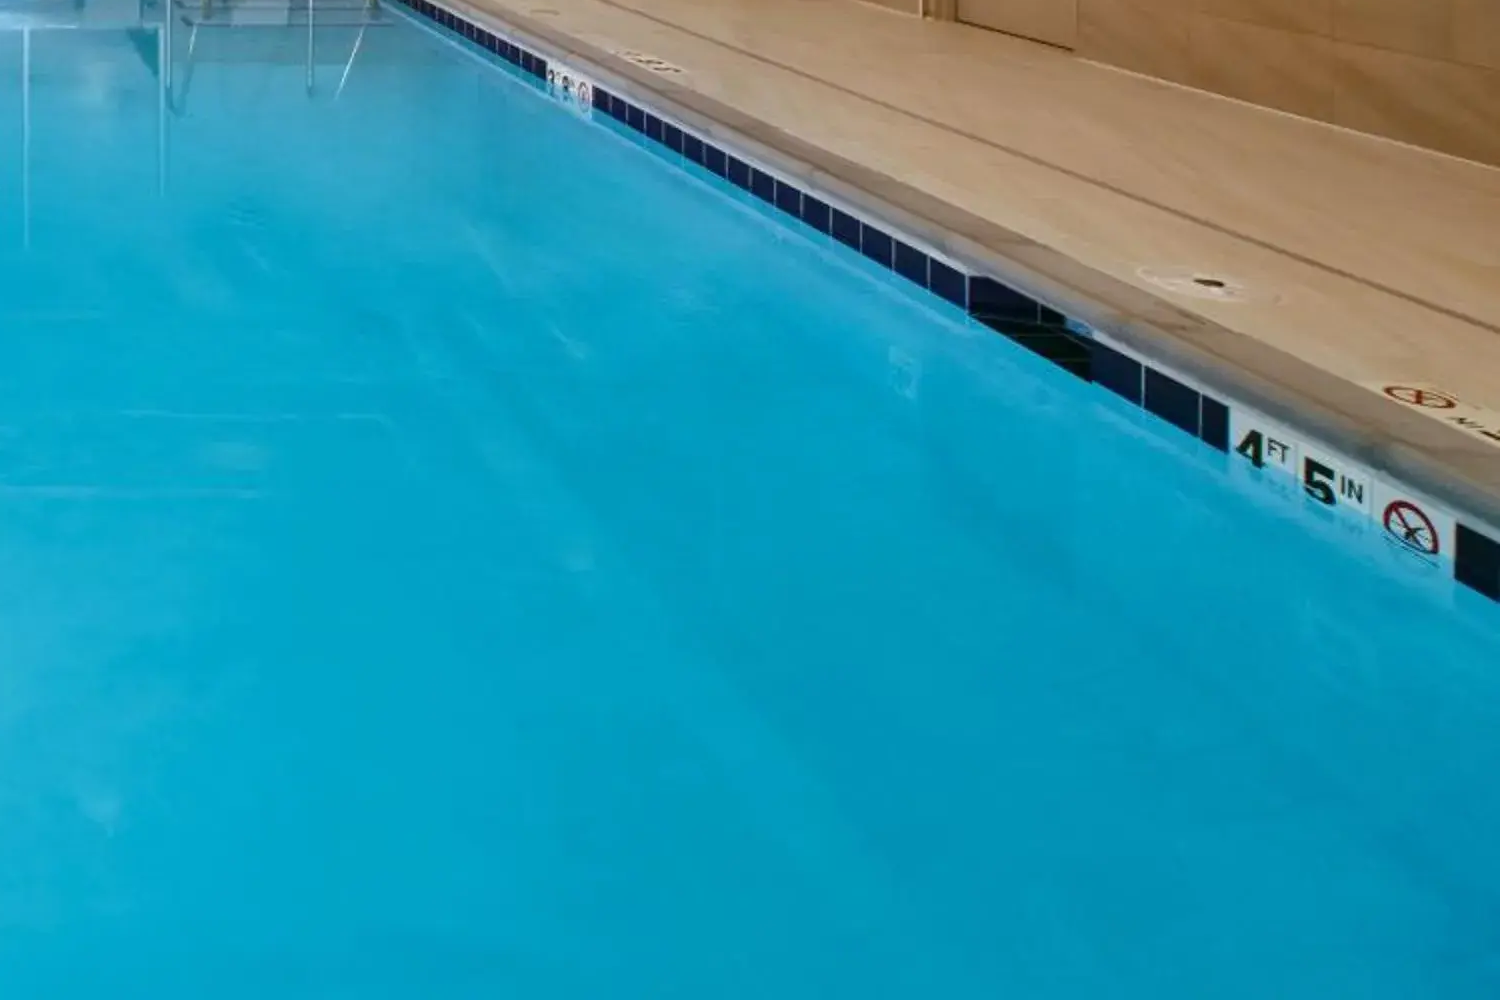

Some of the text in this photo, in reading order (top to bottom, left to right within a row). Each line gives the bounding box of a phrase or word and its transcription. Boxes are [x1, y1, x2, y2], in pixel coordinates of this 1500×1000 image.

[1236, 429, 1364, 506] 4 FT 5 IN
